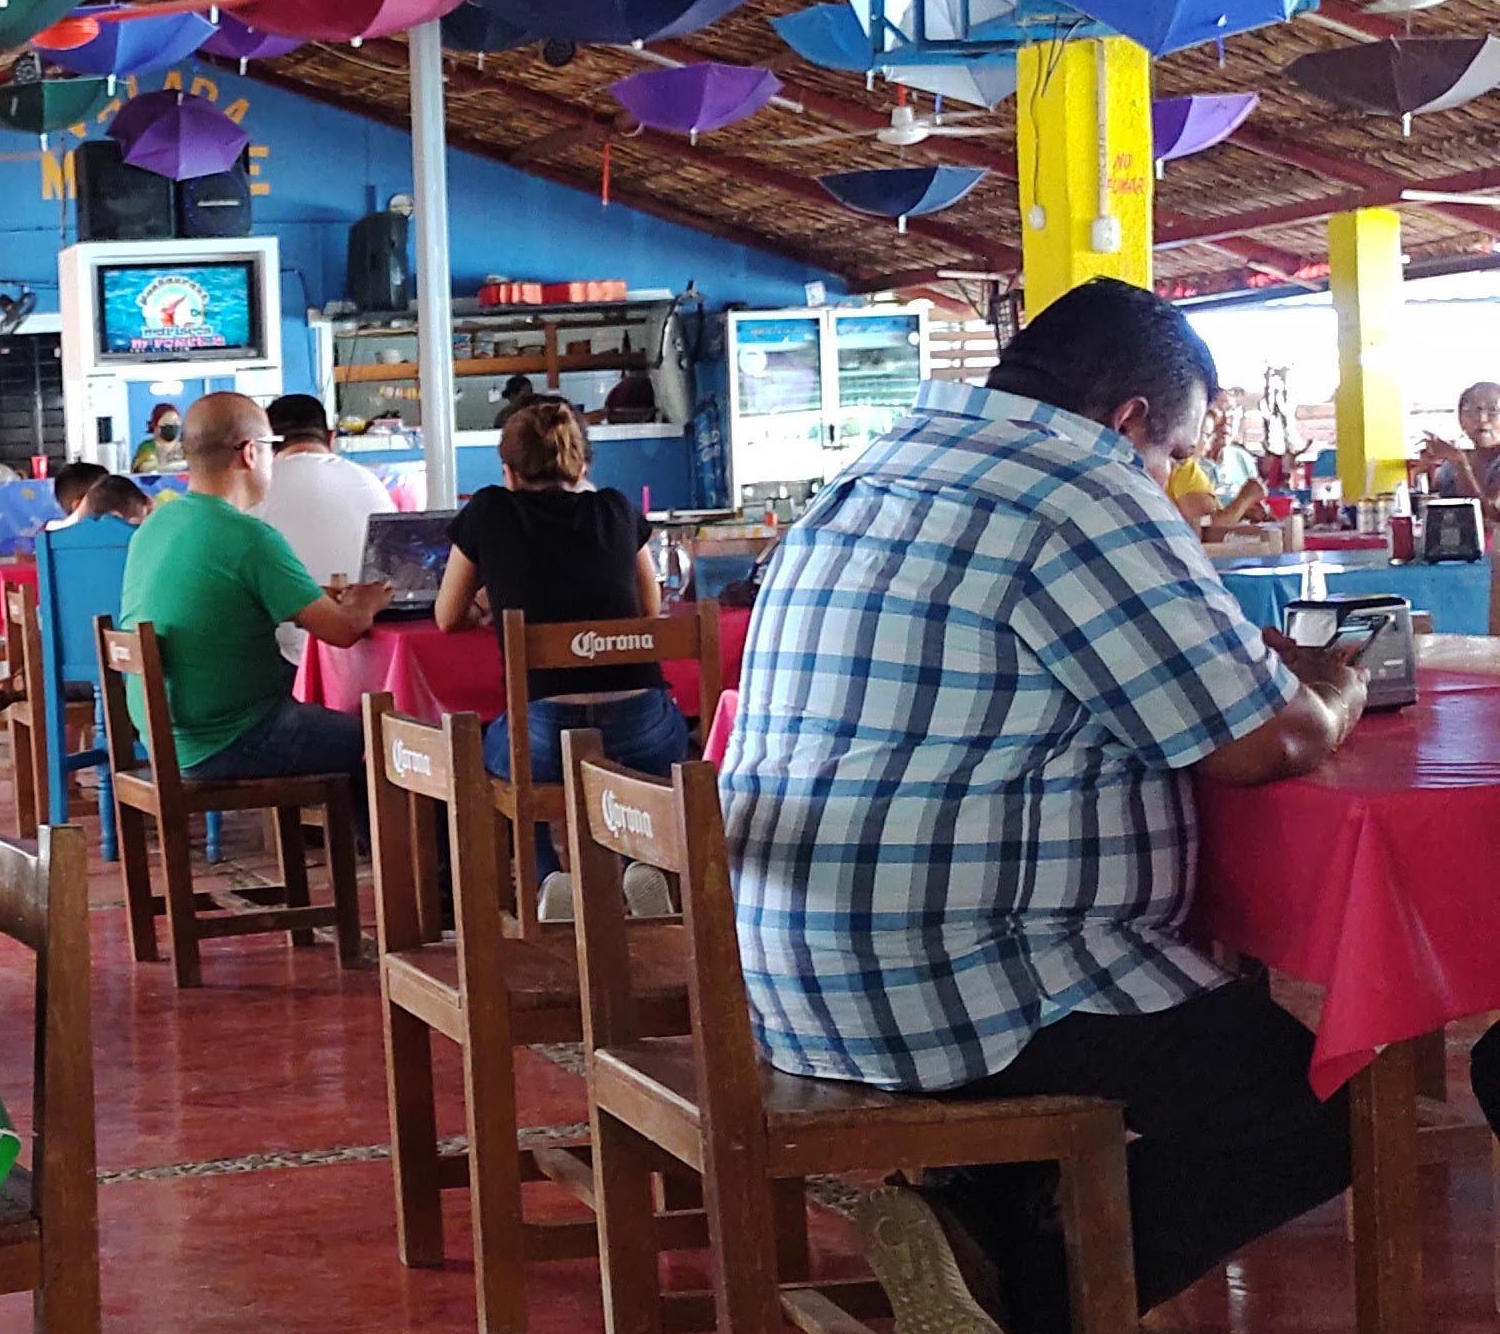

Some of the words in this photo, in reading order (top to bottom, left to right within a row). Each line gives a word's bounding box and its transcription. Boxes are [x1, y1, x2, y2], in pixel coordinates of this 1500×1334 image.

[571, 630, 655, 660] Corona
[392, 738, 431, 777] Corona
[601, 788, 654, 839] Corona
